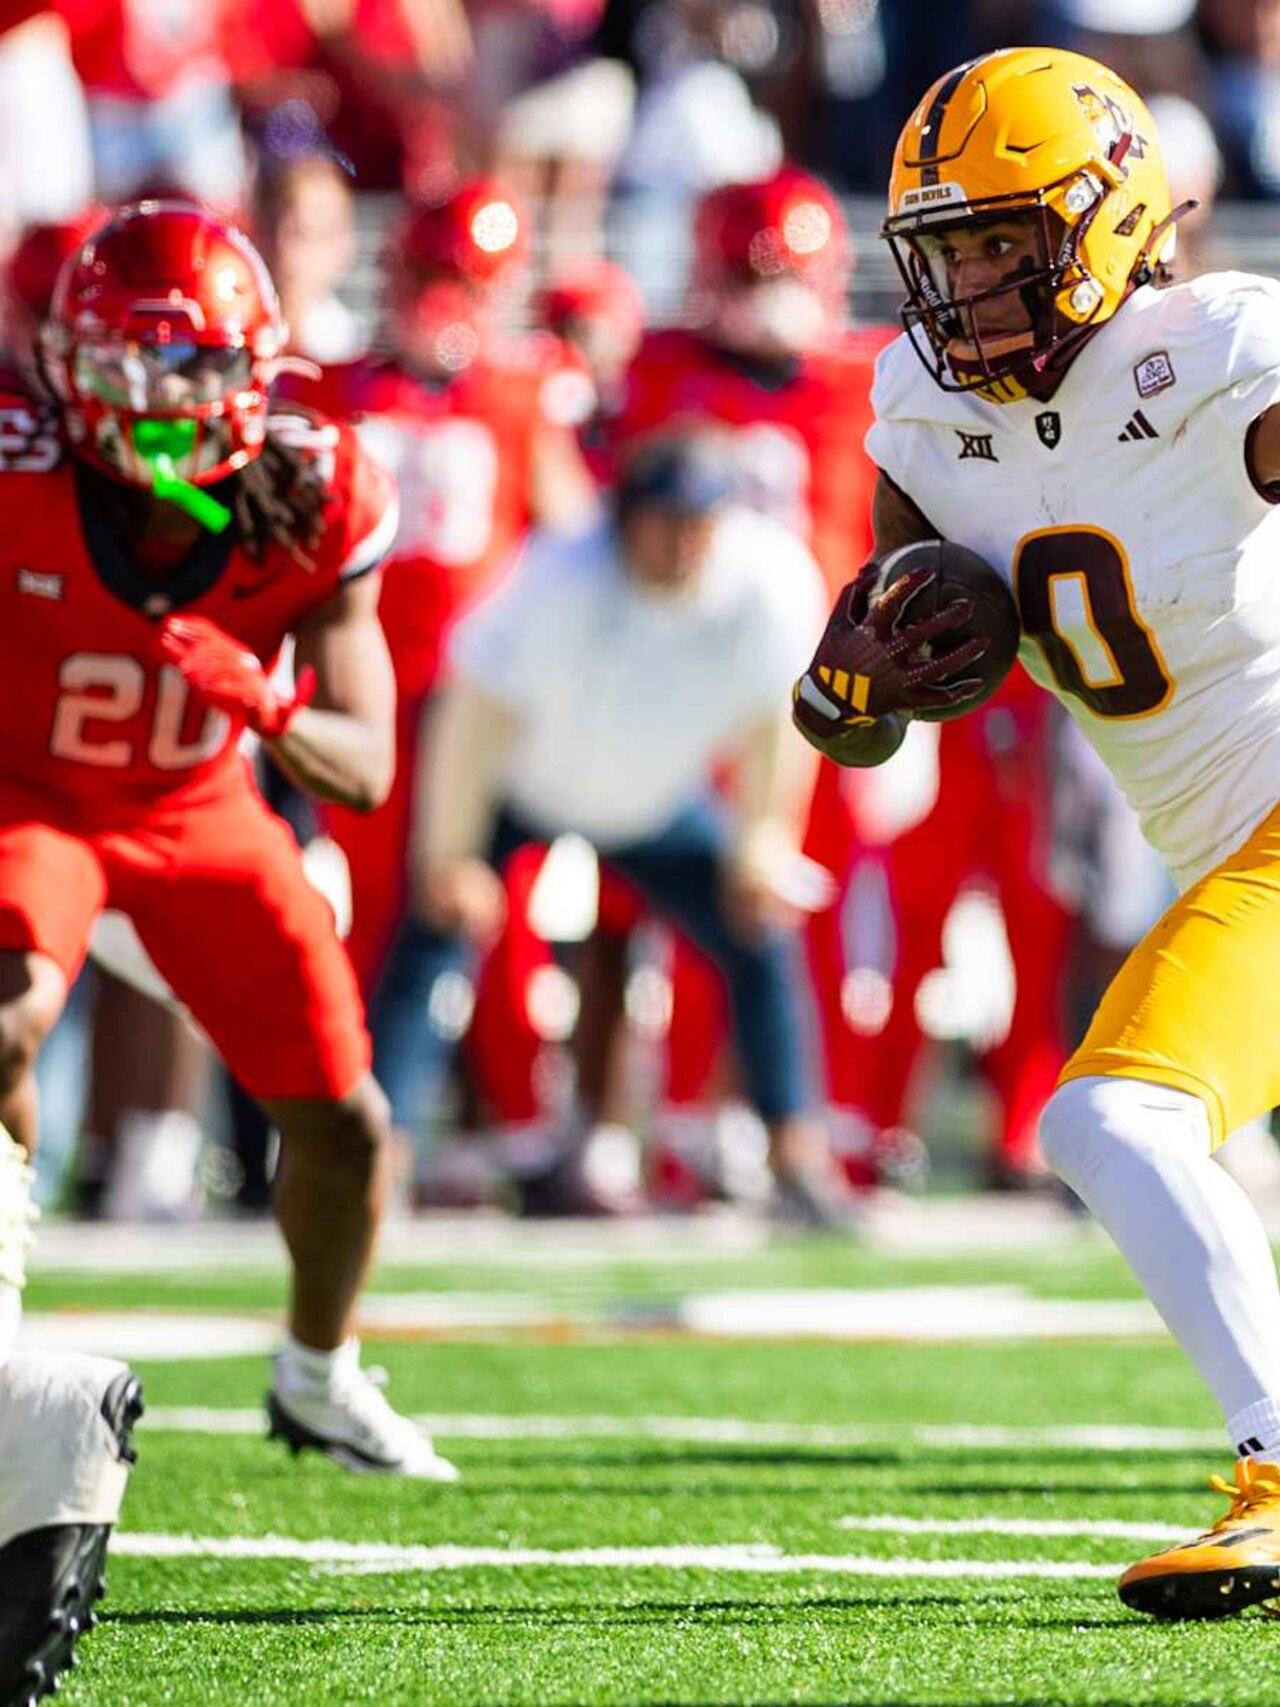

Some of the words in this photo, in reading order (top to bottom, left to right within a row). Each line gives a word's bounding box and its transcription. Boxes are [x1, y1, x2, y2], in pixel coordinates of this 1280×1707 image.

[921, 187, 951, 201] DEVILS
[954, 429, 1000, 463] XII
[1013, 523, 1177, 723] 0
[51, 651, 232, 770] 20
